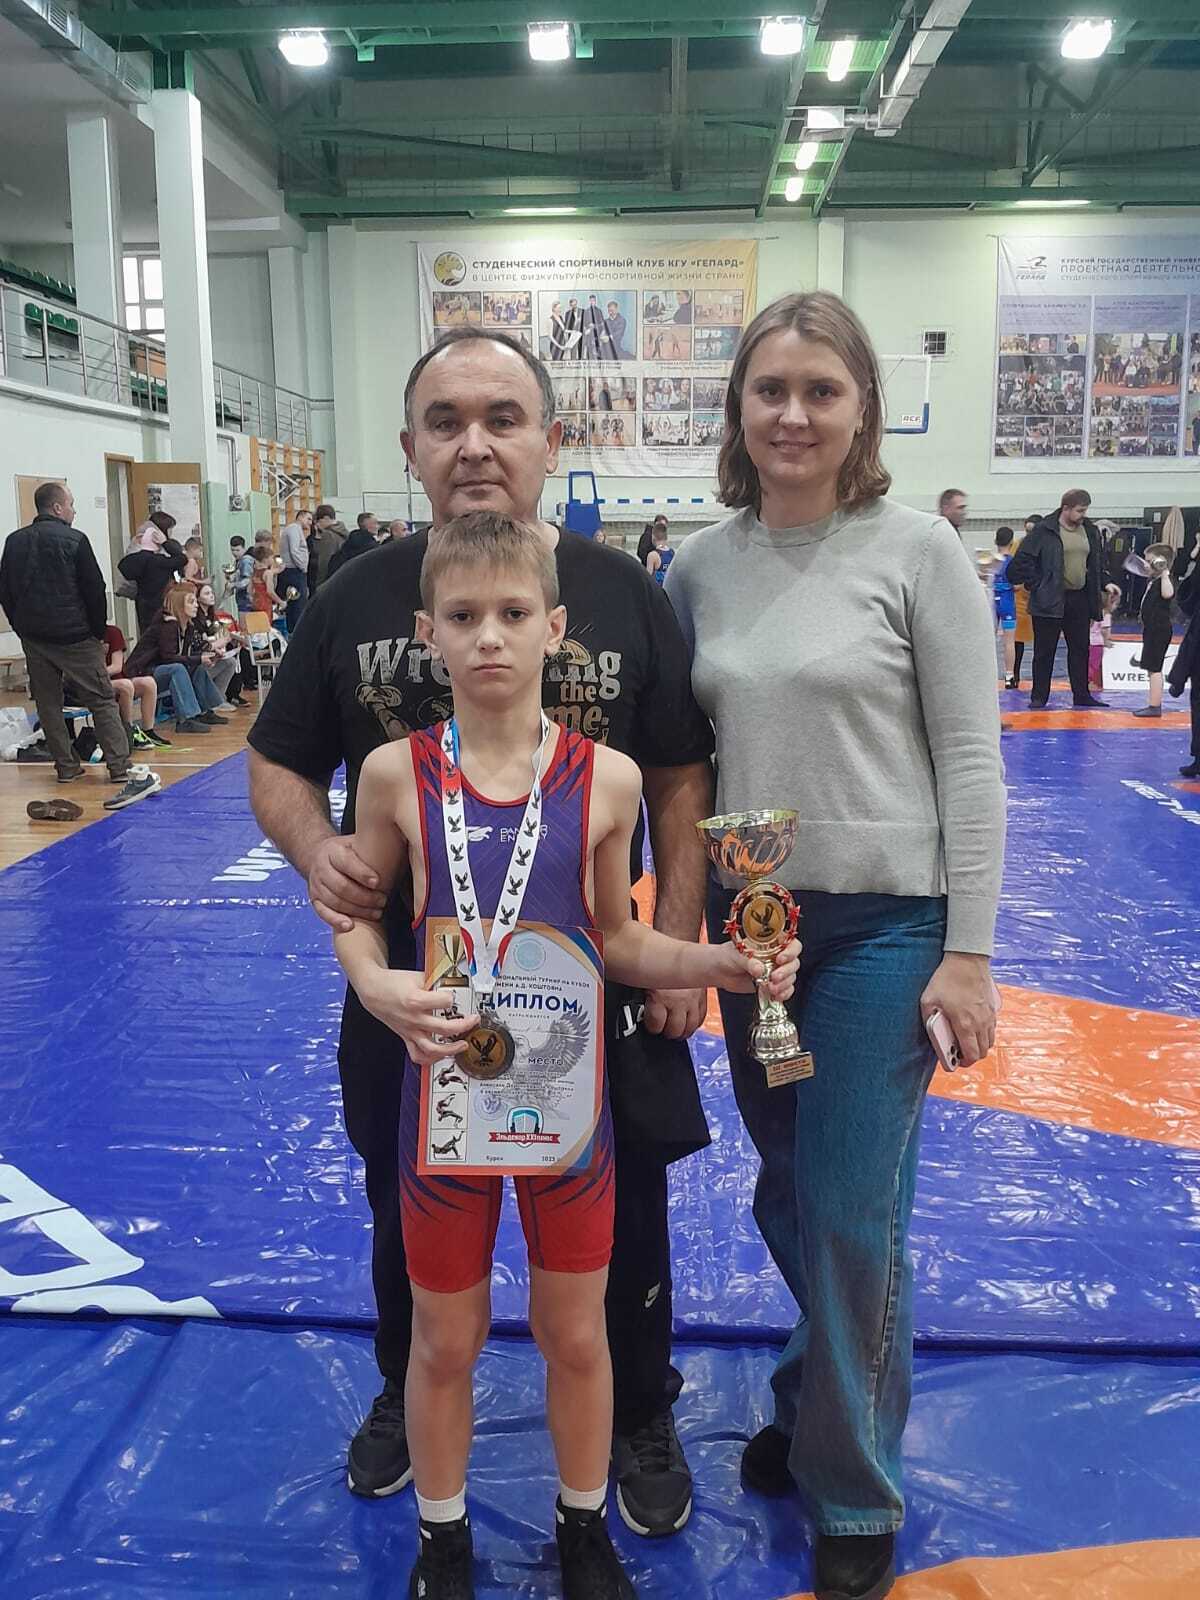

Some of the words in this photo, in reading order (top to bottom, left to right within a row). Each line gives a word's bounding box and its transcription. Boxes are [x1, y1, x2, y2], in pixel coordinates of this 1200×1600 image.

[472, 259, 556, 269] СТУДЕНЧЕСКИЙ
[559, 258, 633, 268] СПОРТИВНЫЙ
[637, 259, 665, 268] КЛУБ
[668, 259, 687, 268] КГУ
[691, 259, 744, 268] «ГЕПАРД»
[1060, 264, 1129, 272] ПРОЕКТНАЯ
[520, 273, 664, 281] ФИЗКУЛЬТУРНО-СПОРТИВНОЙ
[669, 272, 702, 280] ЖИЗНИ
[705, 272, 744, 280] СТРАНЫ
[560, 680, 597, 702] the
[480, 992, 578, 1013] ДИПЛОМ
[528, 1057, 563, 1066] место
